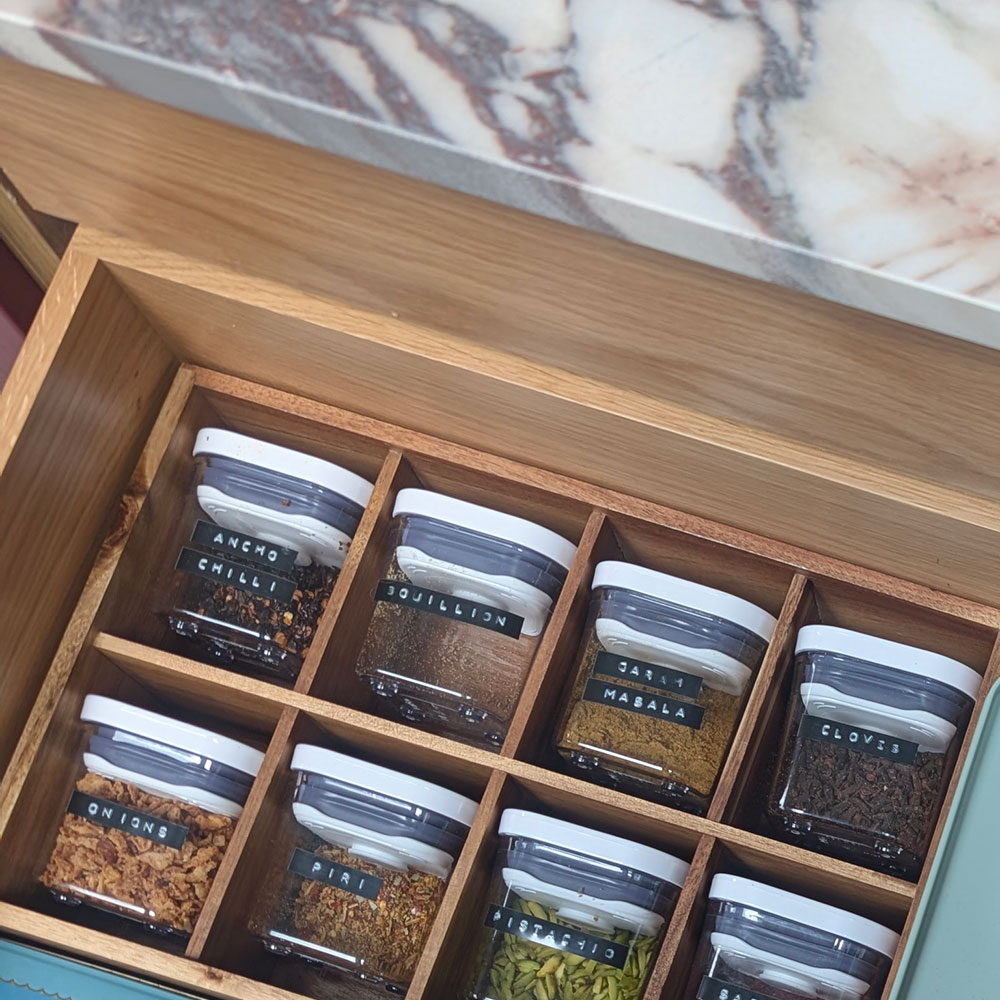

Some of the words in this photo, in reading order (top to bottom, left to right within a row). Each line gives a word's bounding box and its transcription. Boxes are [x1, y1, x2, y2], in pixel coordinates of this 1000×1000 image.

[214, 533, 278, 562] ANCHO
[198, 558, 276, 592] CHILLI
[386, 586, 506, 626] BOUILLION
[618, 662, 684, 688] GARAM
[604, 688, 685, 718] MASALA
[822, 724, 900, 754] CLOVES
[88, 803, 168, 840] ONIONS
[312, 862, 365, 889] PIRI
[493, 910, 614, 958] PISTACHIO
